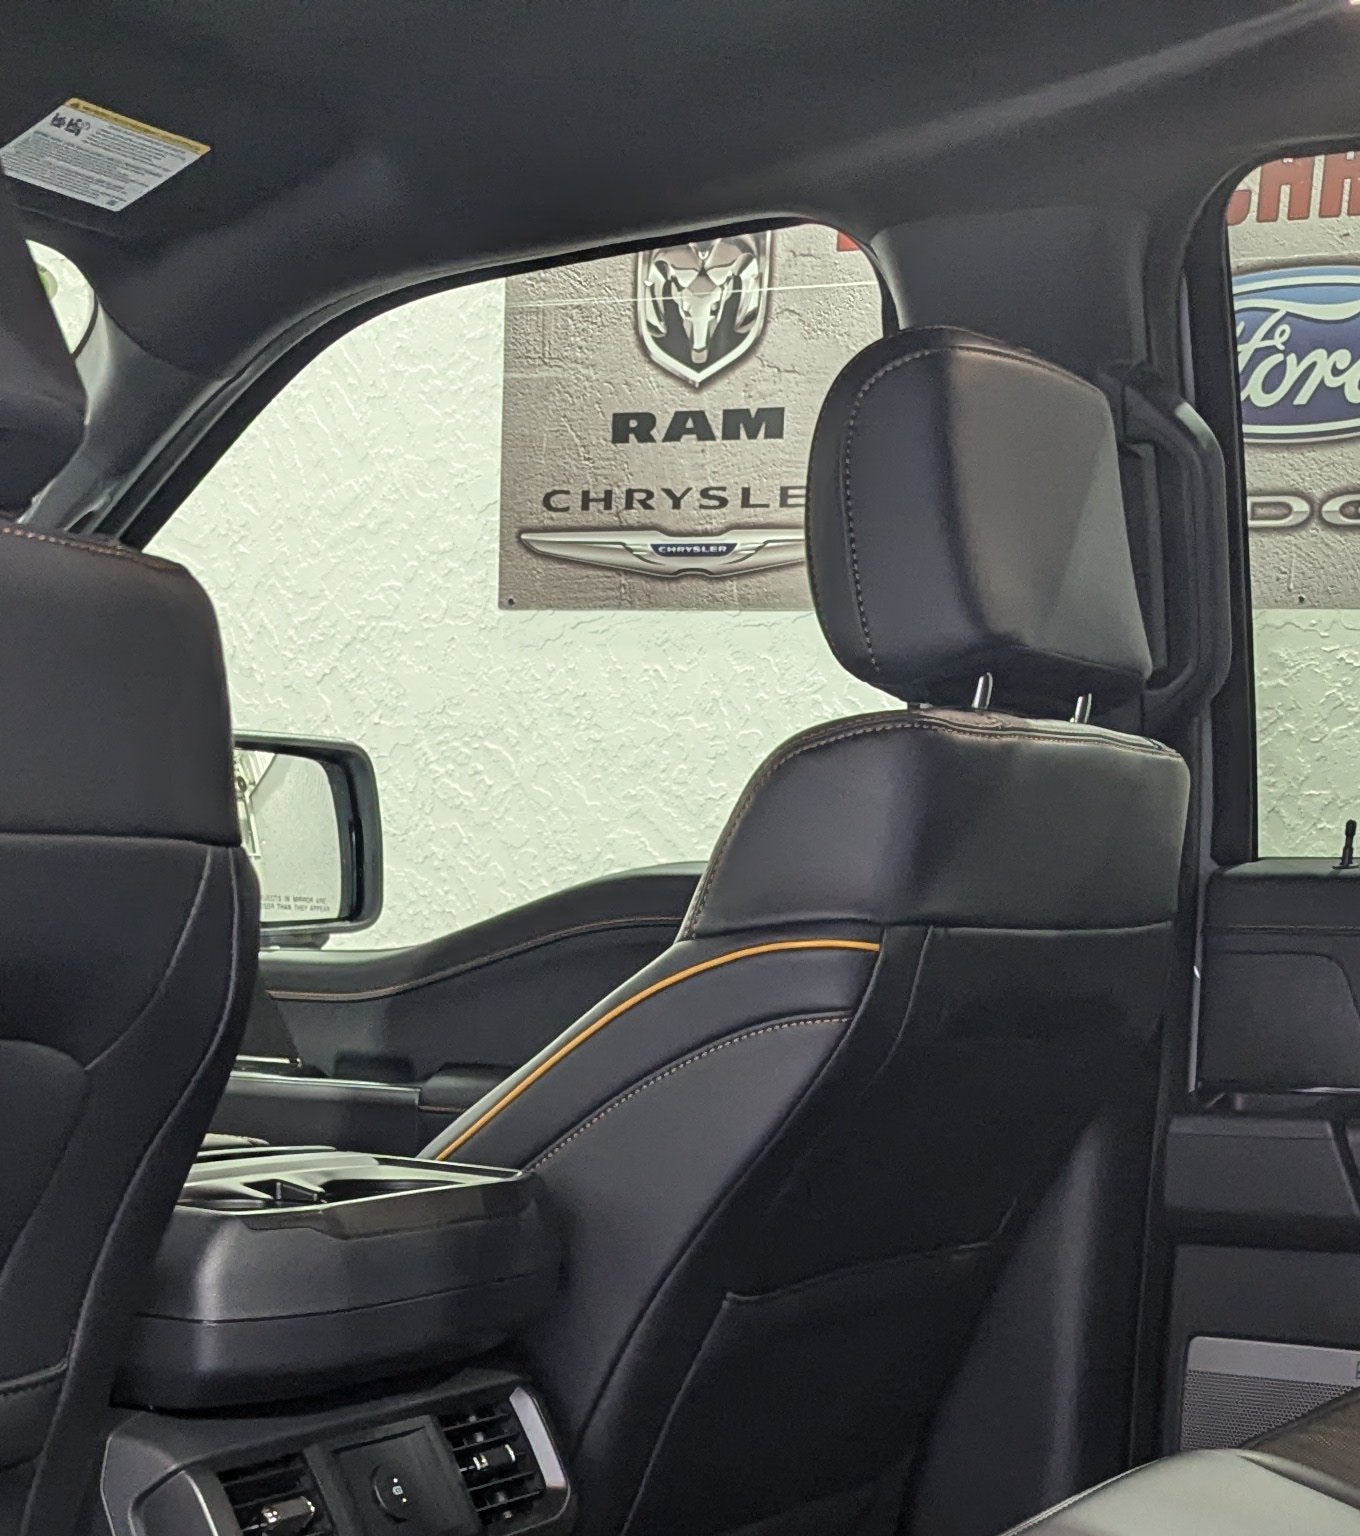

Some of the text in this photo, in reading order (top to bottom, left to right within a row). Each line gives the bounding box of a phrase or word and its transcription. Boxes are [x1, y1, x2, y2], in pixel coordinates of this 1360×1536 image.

[612, 407, 785, 444] RAM
[542, 486, 807, 513] CHRYSLE
[658, 545, 727, 553] CHRYSLER
